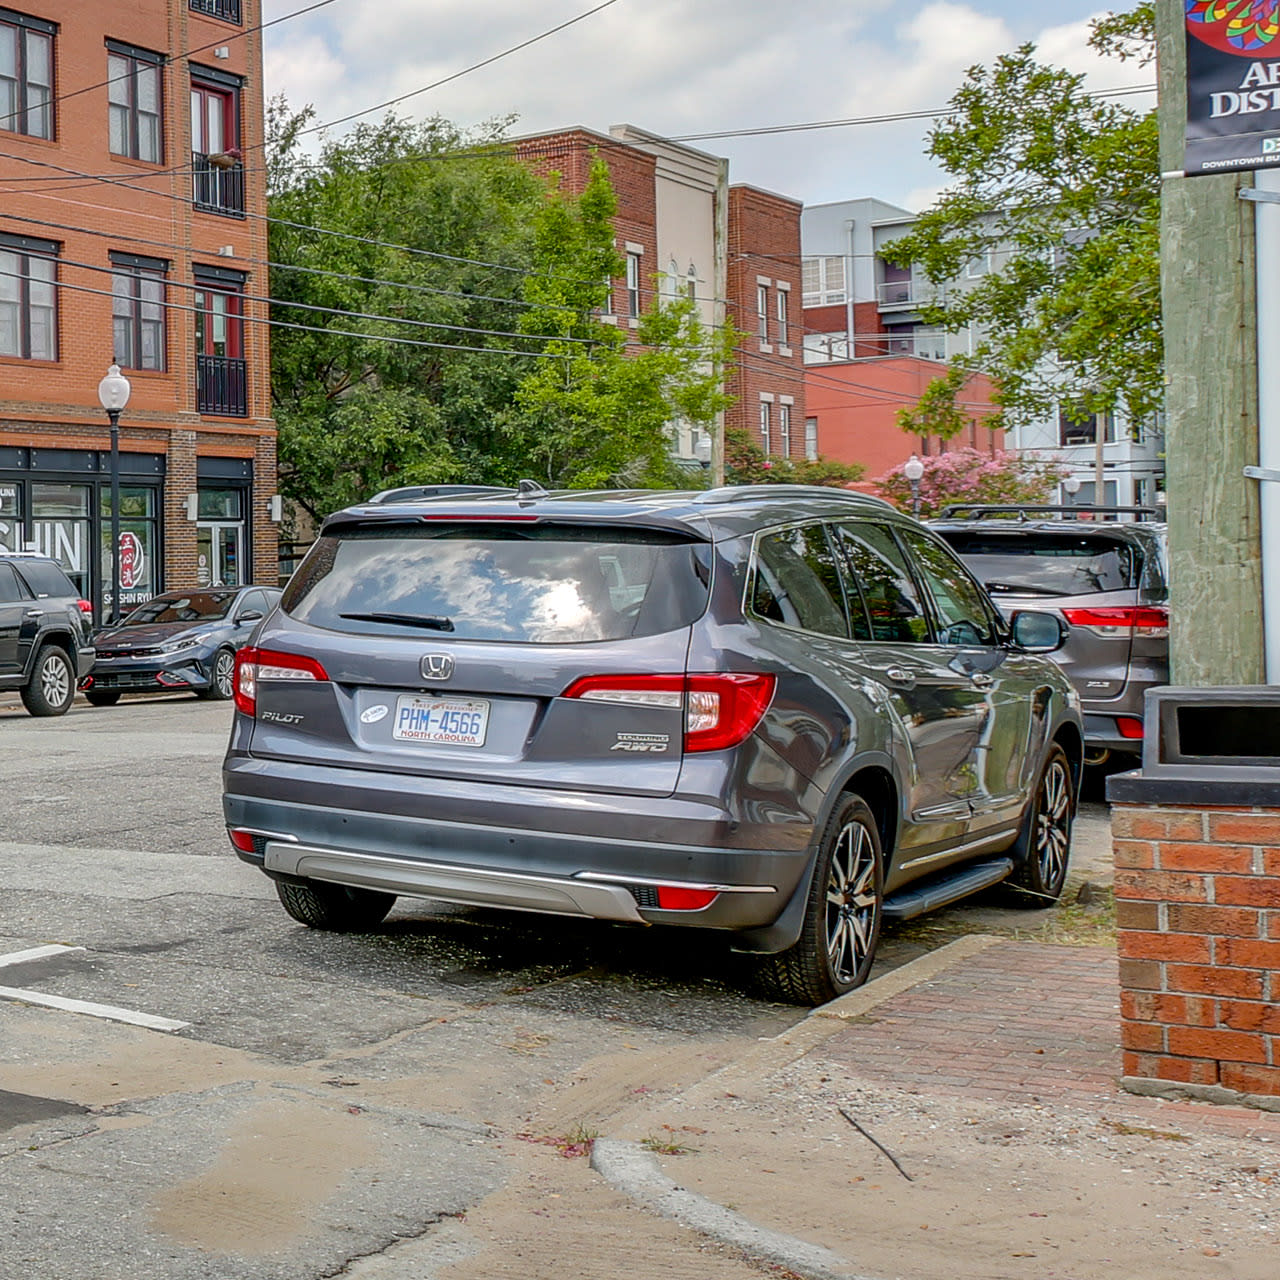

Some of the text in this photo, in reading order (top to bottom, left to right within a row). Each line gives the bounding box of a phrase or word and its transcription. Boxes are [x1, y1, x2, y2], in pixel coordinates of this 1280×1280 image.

[1202, 156, 1264, 169] DOWNTOWN
[103, 592, 137, 604] SHSHIN
[262, 711, 305, 724] PILOT
[398, 707, 482, 735] PHM-4566
[401, 729, 476, 743] NORTH CAROLINA
[609, 741, 667, 751] AWD
